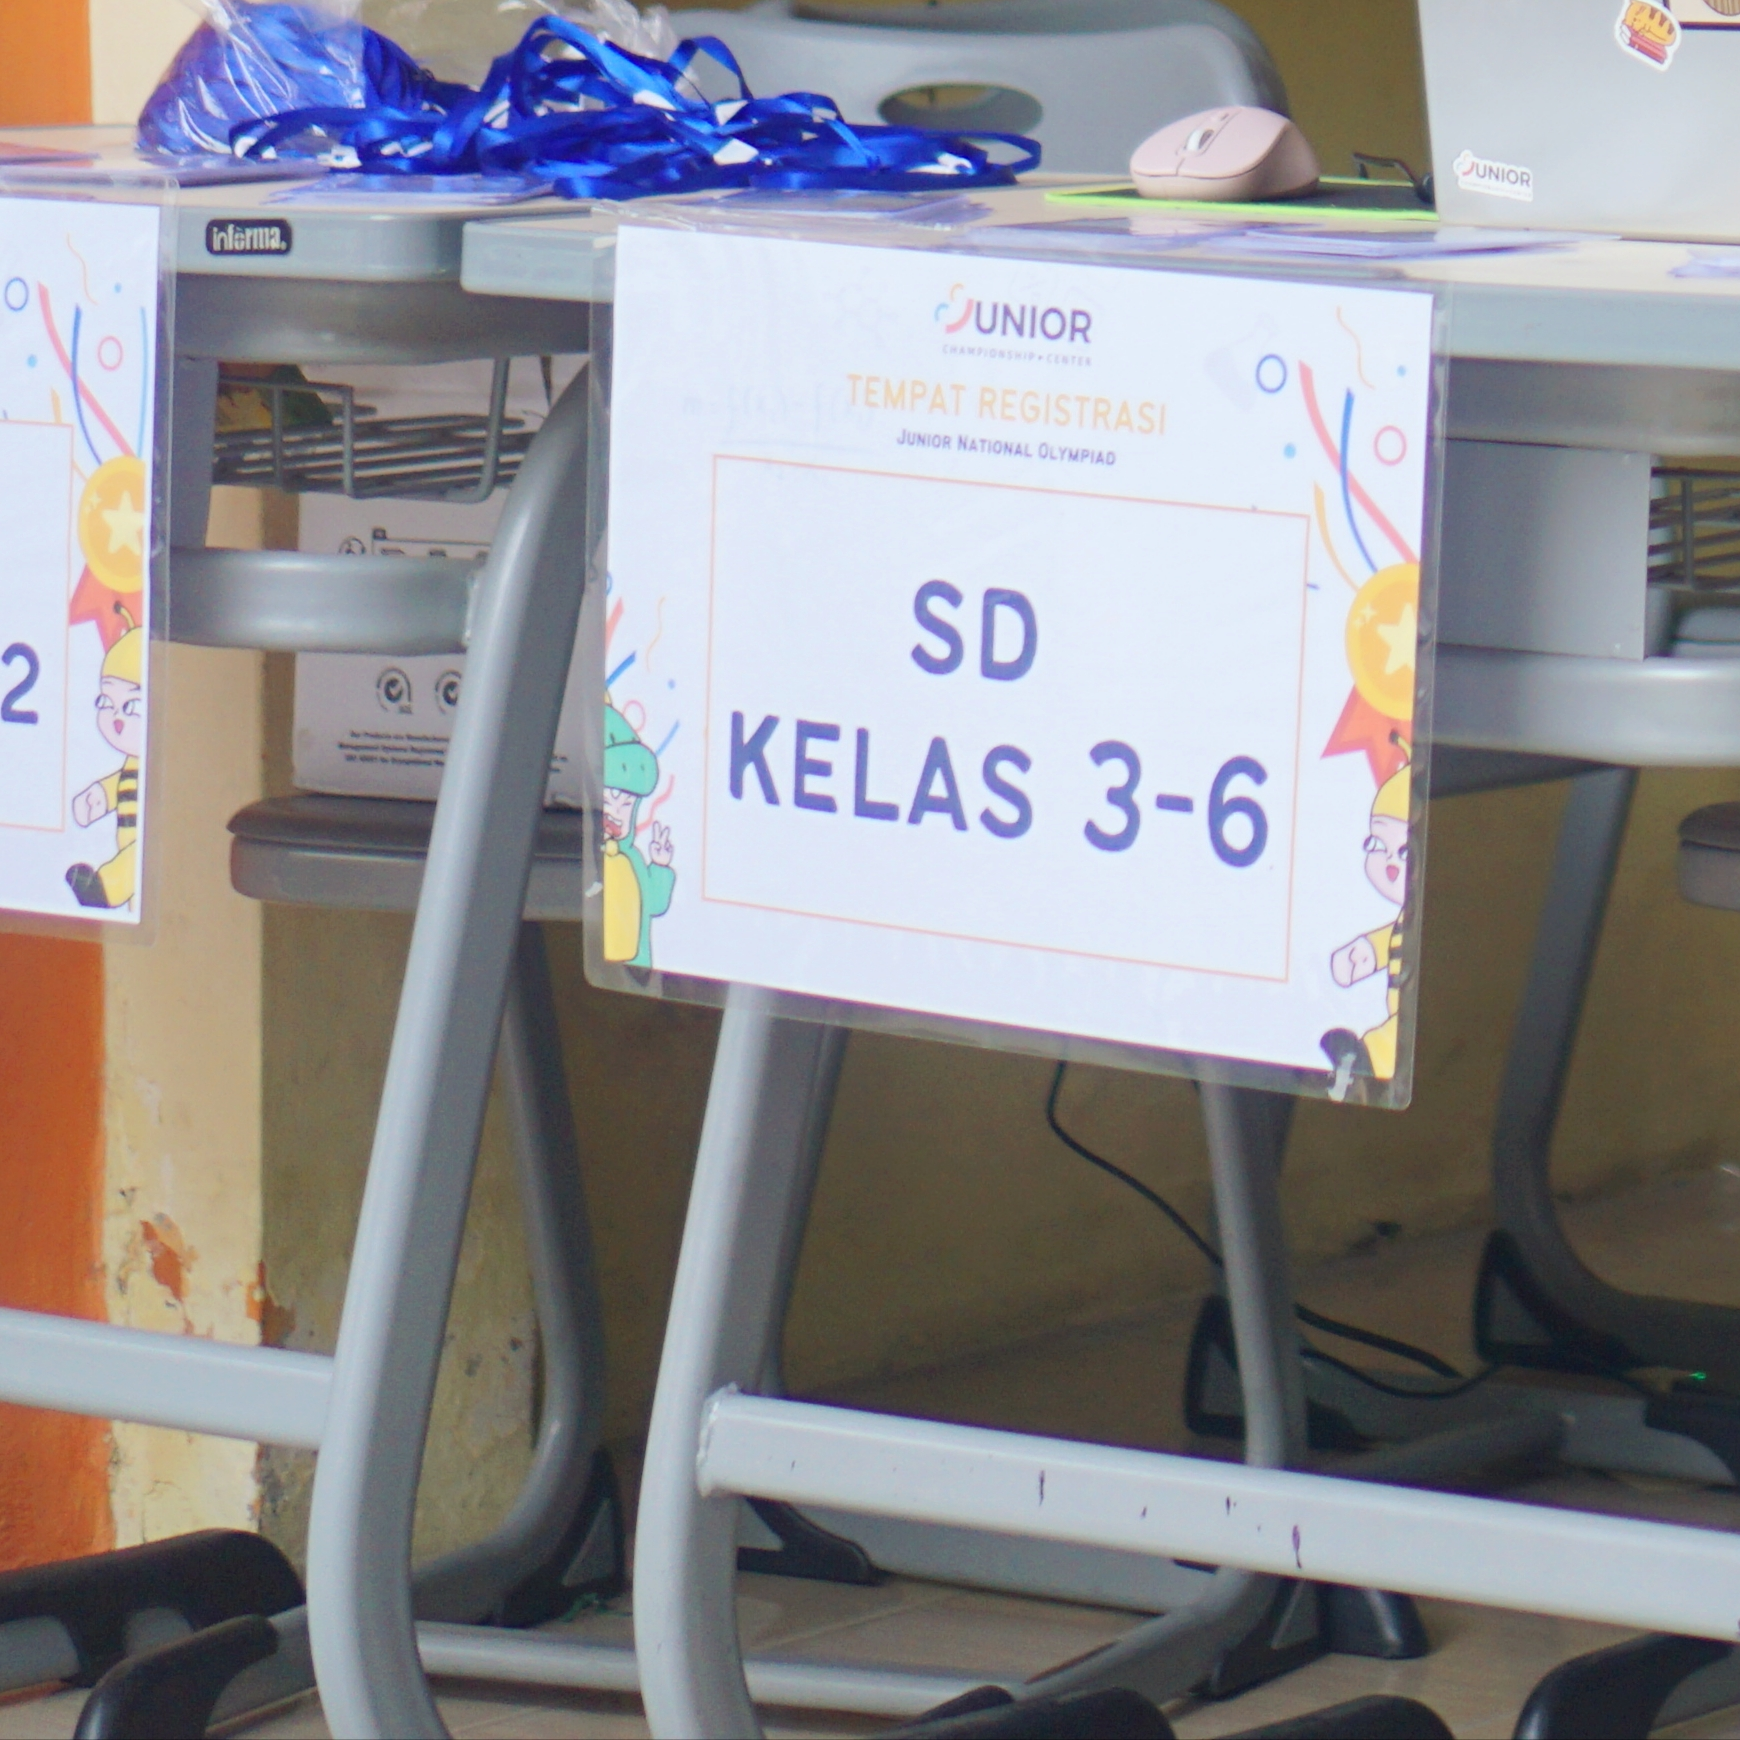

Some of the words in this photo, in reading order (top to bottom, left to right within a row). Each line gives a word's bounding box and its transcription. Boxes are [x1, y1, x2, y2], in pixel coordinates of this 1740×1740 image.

[938, 290, 1093, 344] JUNIOR
[1046, 353, 1093, 367] CENTER
[847, 373, 967, 417] TEMPAT
[978, 385, 1167, 437] REGISTRASI
[909, 578, 1039, 683] SD
[727, 709, 1034, 840] KELAS
[1083, 738, 1270, 869] 3-6
